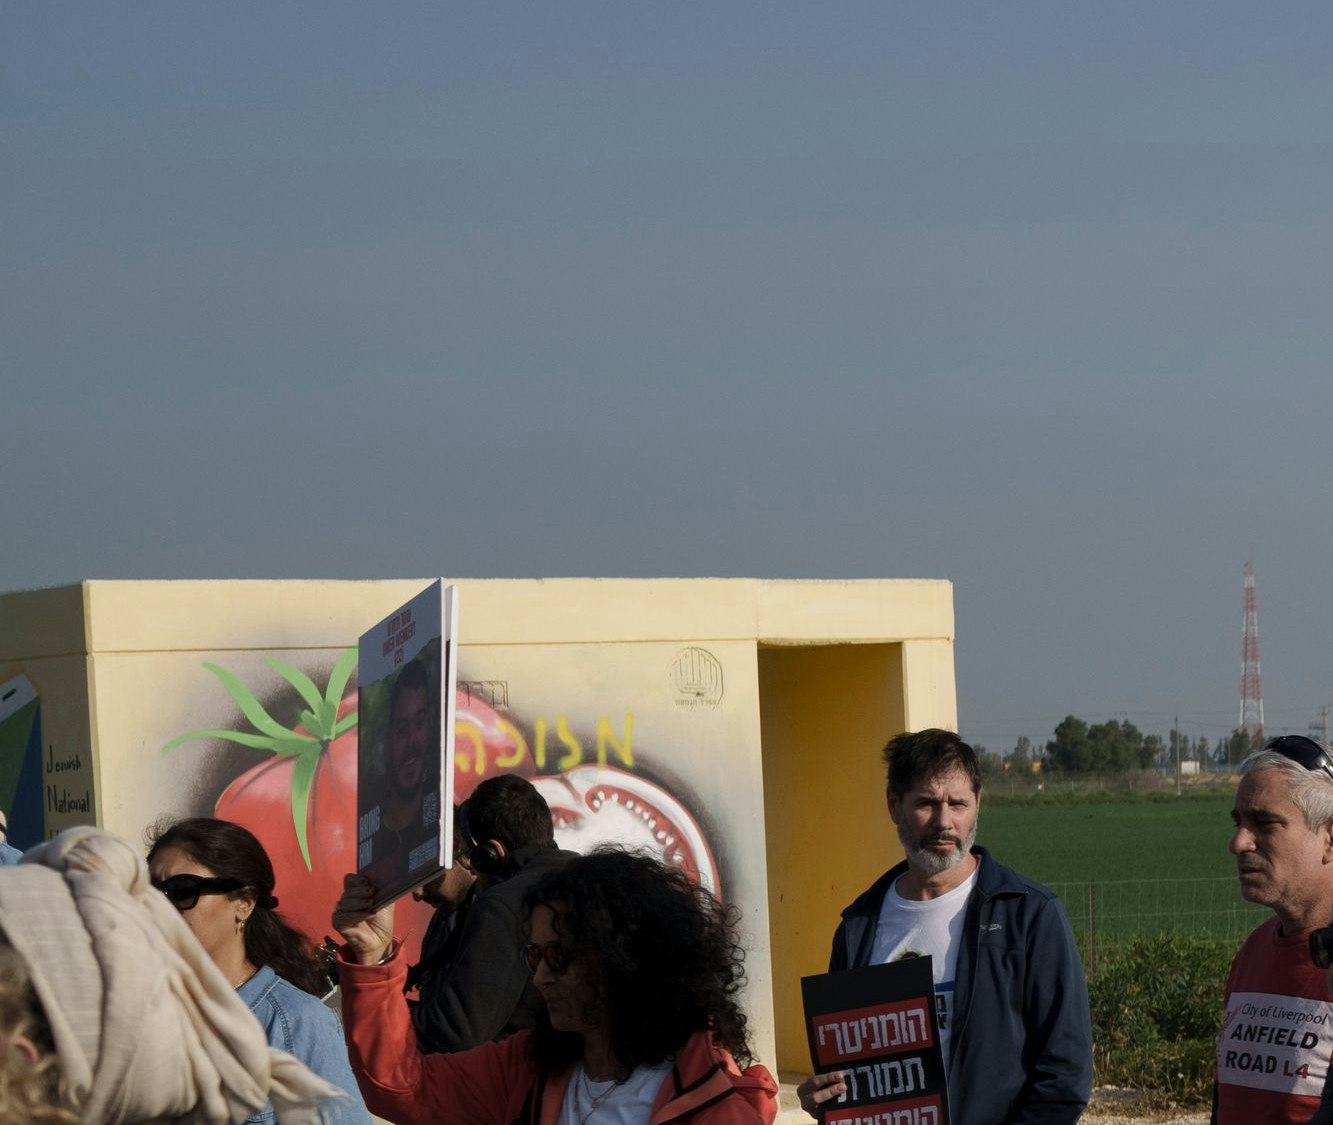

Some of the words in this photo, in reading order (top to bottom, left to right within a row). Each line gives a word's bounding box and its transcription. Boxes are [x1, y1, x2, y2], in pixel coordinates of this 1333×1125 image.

[46, 744, 82, 774] Jewish
[46, 785, 91, 814] National
[1241, 1002, 1259, 1019] City
[1260, 1005, 1272, 1017] of
[1272, 1006, 1328, 1025] Liverpool
[817, 1007, 929, 1056] הומניטרי
[1230, 1023, 1319, 1050] ANFIELD
[1225, 1050, 1278, 1074] ROAD
[1283, 1060, 1309, 1079] L4
[837, 1056, 927, 1103] תמורת
